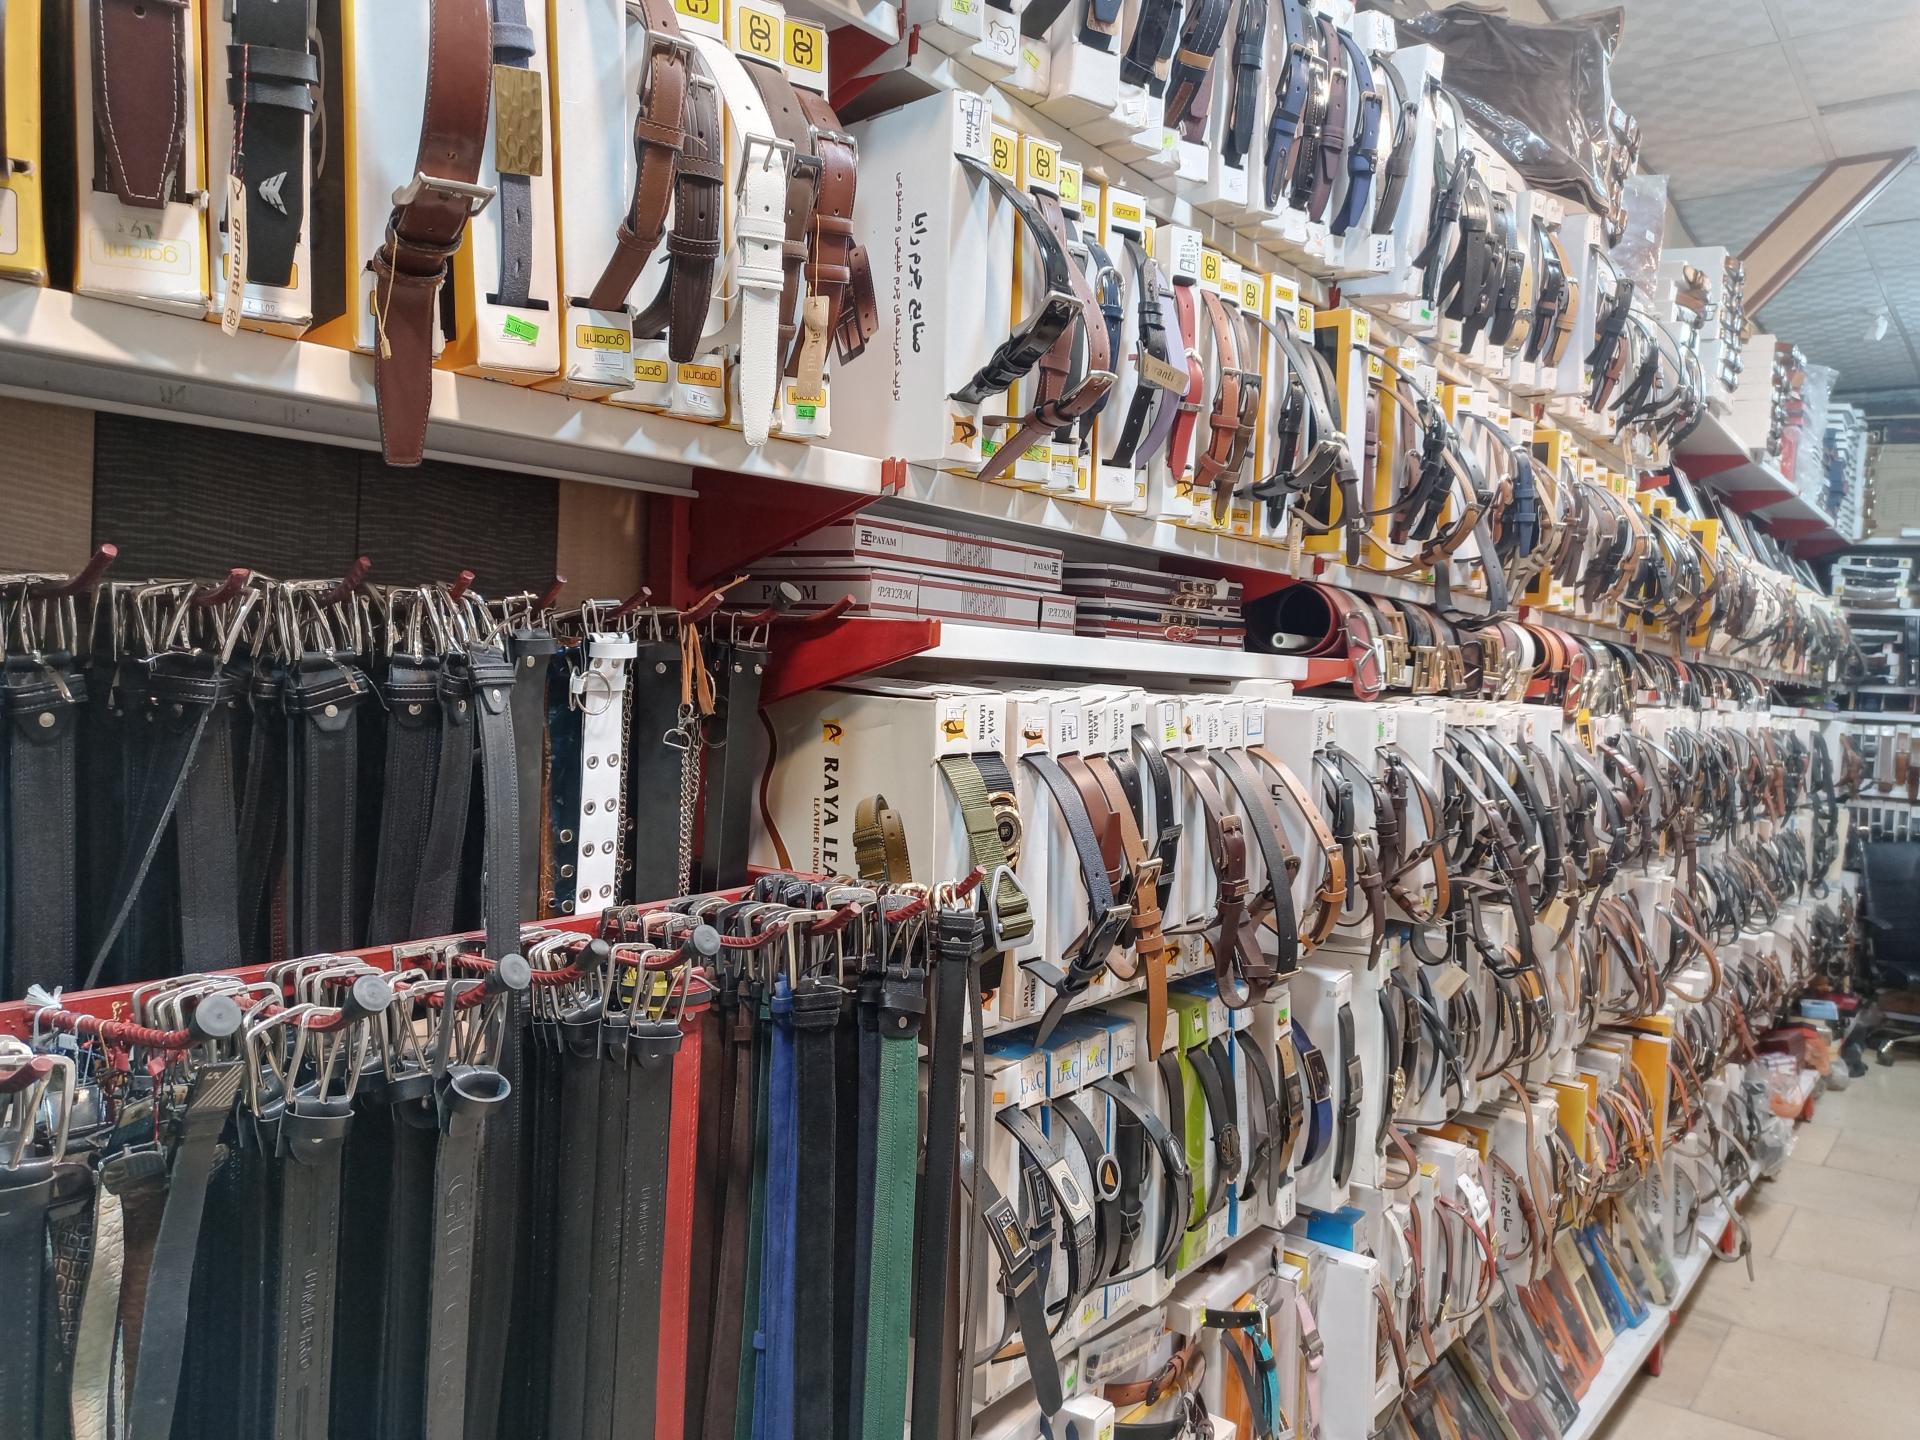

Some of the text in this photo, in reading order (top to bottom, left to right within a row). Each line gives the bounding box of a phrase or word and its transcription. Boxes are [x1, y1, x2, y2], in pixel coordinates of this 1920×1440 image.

[231, 217, 241, 297] garanti
[894, 237, 904, 273] طبیعی
[892, 276, 902, 301] چرم
[907, 211, 928, 354] صنایع چرم رایا
[583, 332, 625, 347] garanti
[634, 364, 662, 377] gara
[683, 369, 717, 382] garanti
[892, 368, 901, 402] تولید
[872, 536, 897, 547] PAYAM
[1033, 561, 1052, 571] PAYAM
[762, 585, 817, 600] PAM
[877, 586, 913, 600] PAYAM
[1047, 606, 1073, 619] PAYAM
[823, 757, 839, 827] RAYA
[812, 797, 820, 844] LEATHER
